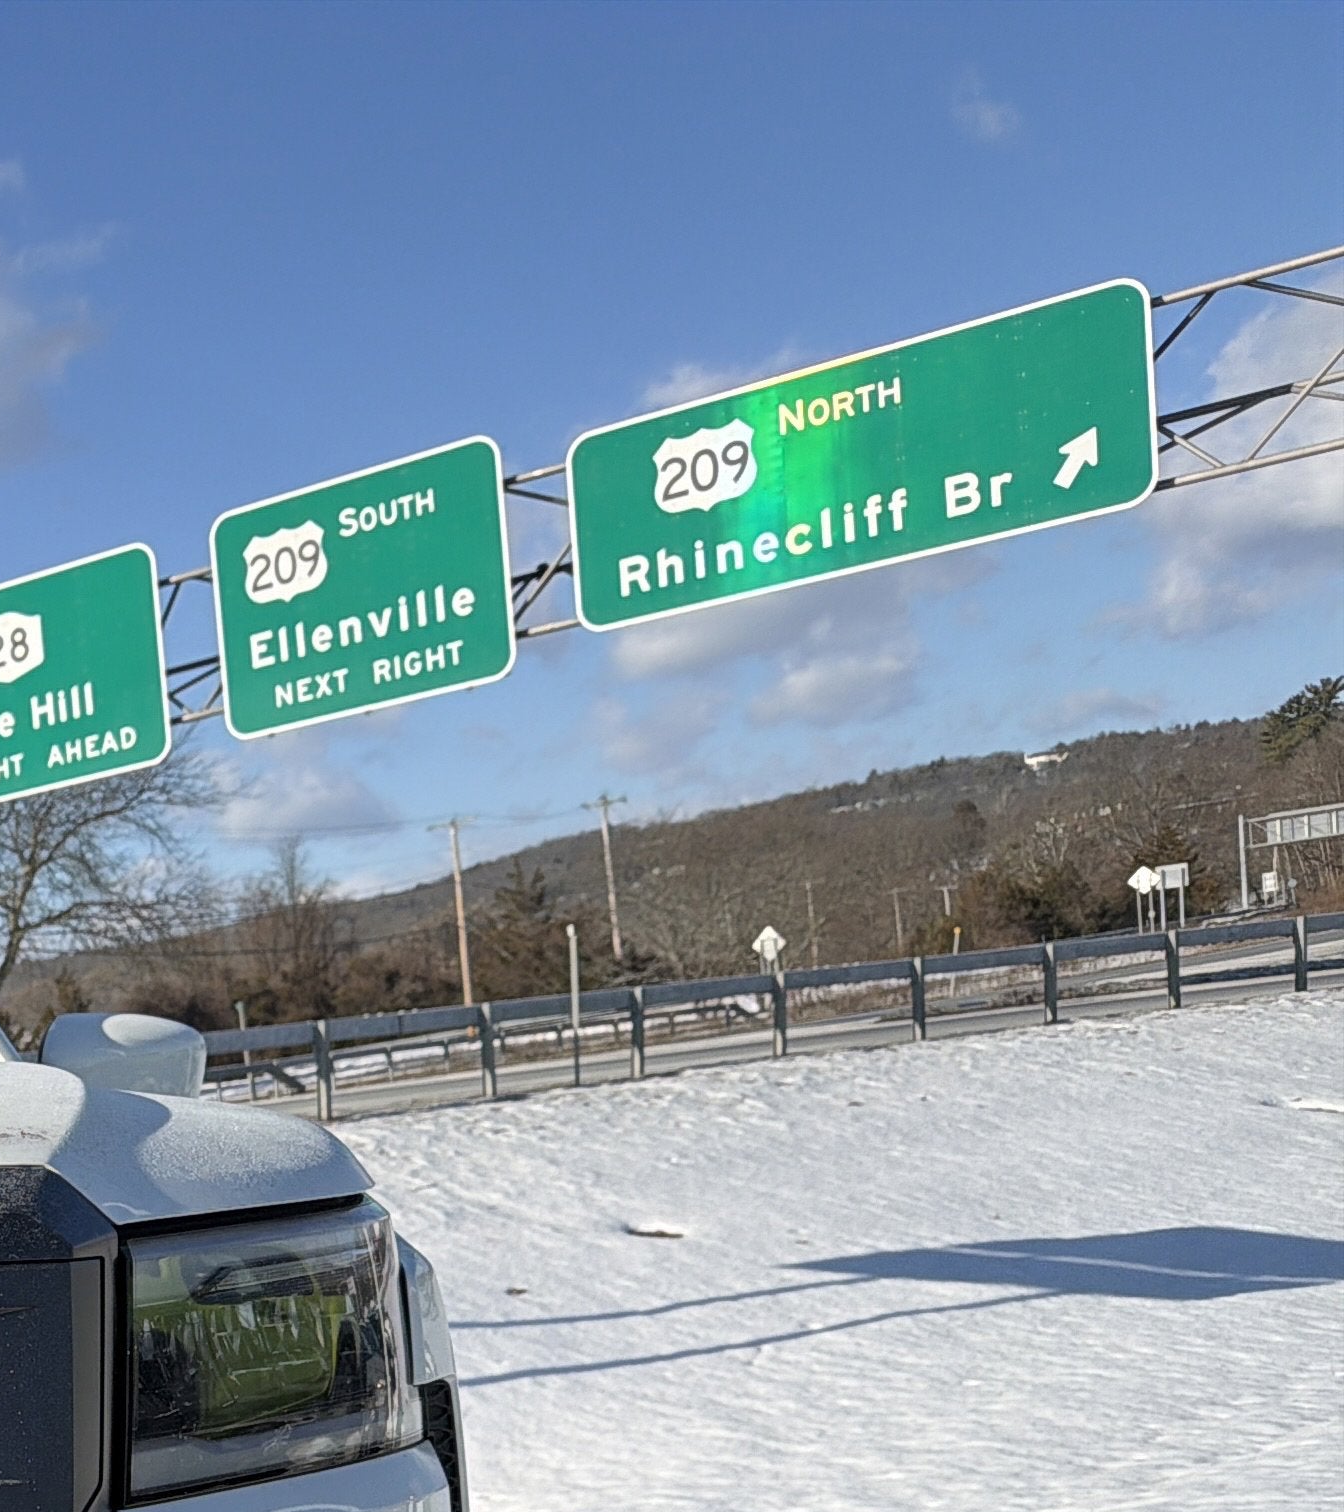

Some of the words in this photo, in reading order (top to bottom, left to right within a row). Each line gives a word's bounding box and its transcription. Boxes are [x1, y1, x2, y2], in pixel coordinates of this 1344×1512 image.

[778, 377, 902, 435] NORTH
[659, 440, 749, 501] 209
[338, 488, 436, 537] SOUTH
[618, 488, 908, 597] Rhinecliff
[944, 472, 1013, 518] Br
[249, 539, 320, 593] 209
[249, 585, 475, 669] Ellenville
[274, 668, 349, 708] NEXT
[372, 640, 463, 684] RIGHT
[30, 681, 94, 730] Hill
[47, 726, 137, 768] AHEAD
